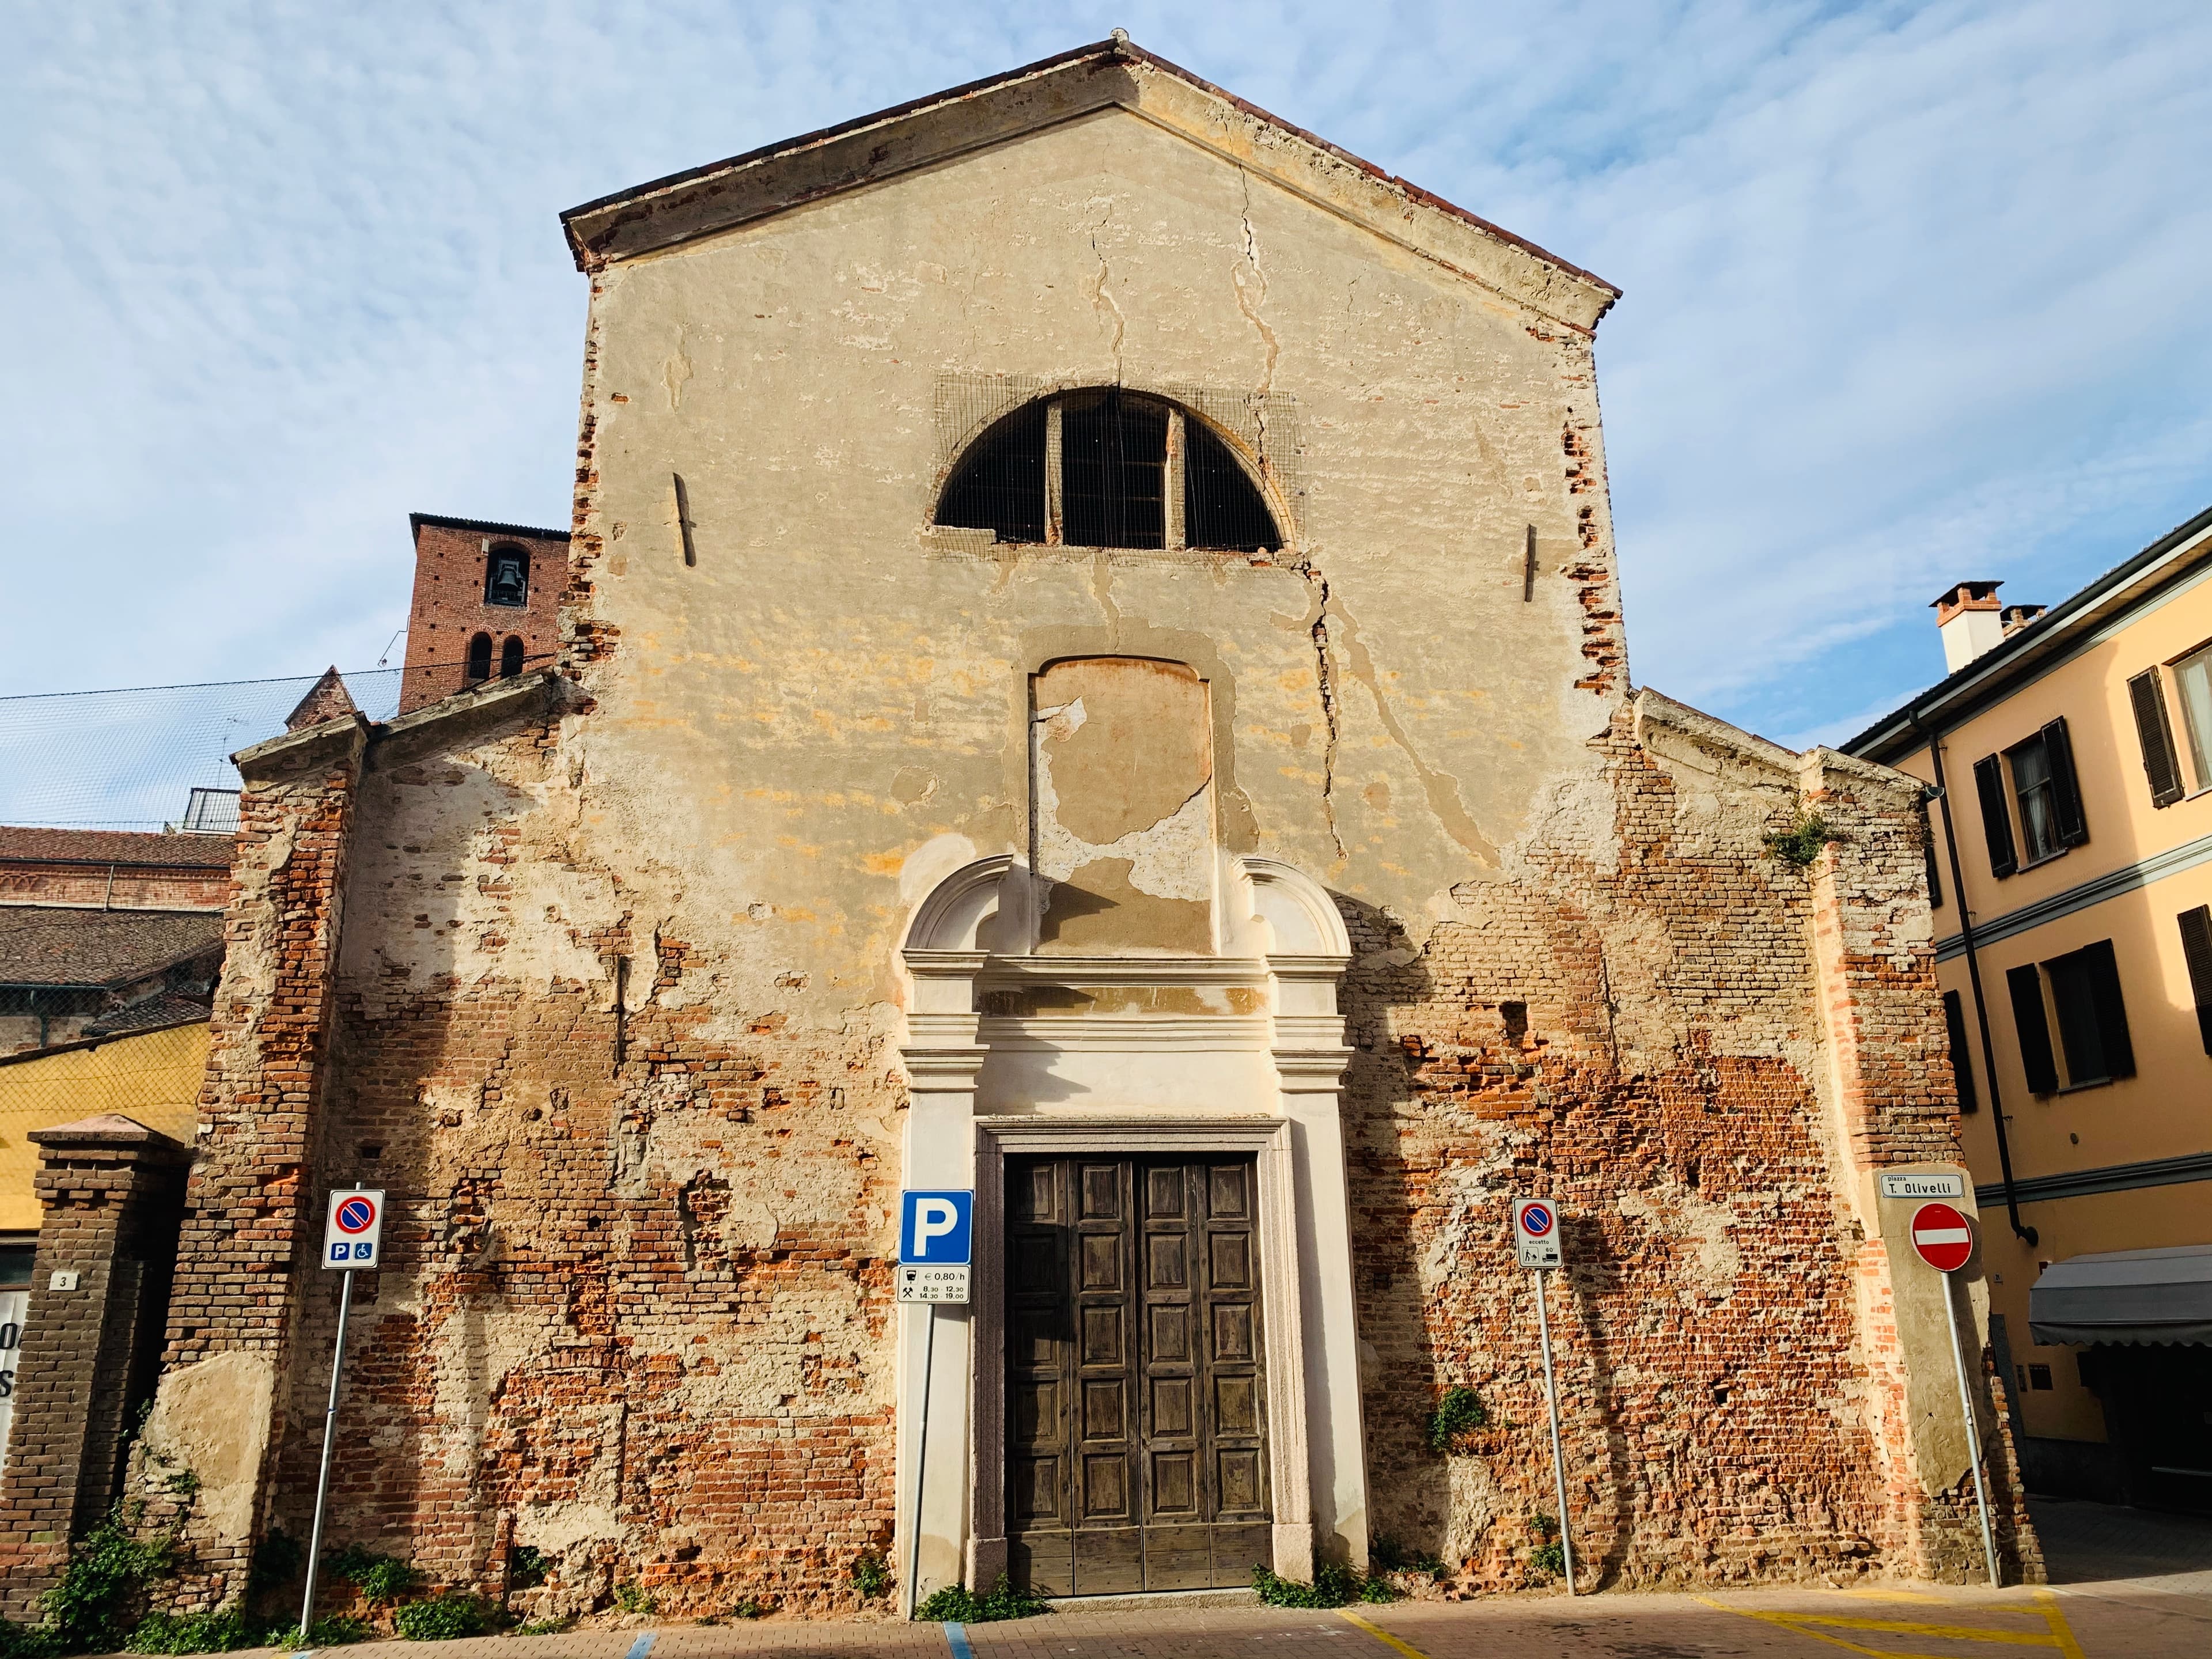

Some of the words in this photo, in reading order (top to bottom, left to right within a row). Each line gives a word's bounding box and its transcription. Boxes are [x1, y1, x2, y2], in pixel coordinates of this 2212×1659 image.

[1889, 1183, 1897, 1194] T.
[1905, 1183, 1951, 1194] Olivelli
[914, 1198, 958, 1256] P
[335, 1245, 346, 1258] P
[60, 1277, 66, 1287] 3
[934, 1272, 965, 1281] 0,80/h
